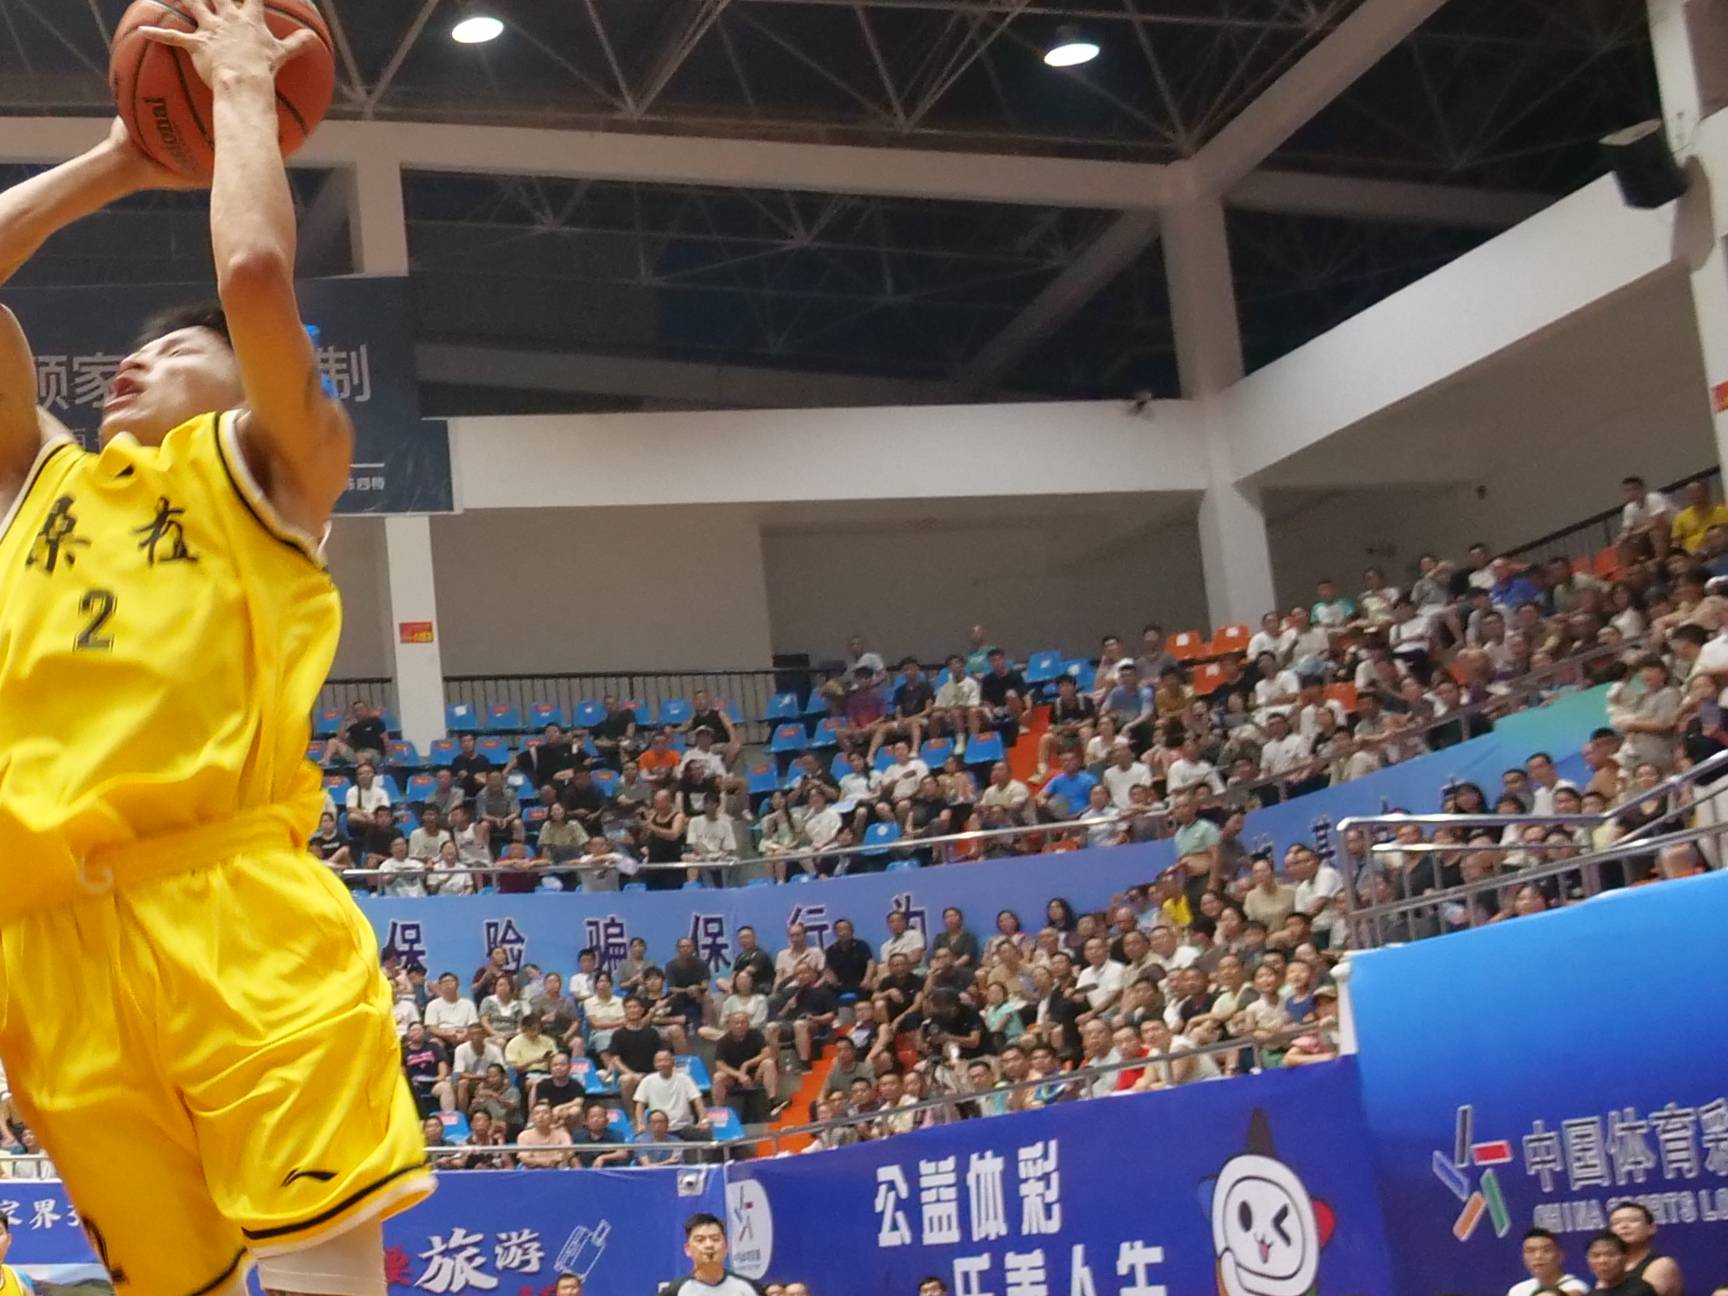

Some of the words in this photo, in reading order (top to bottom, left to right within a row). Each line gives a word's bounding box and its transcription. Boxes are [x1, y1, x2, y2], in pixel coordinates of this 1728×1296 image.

[73, 588, 117, 653] 2
[873, 1138, 1062, 1249] 公益体彩
